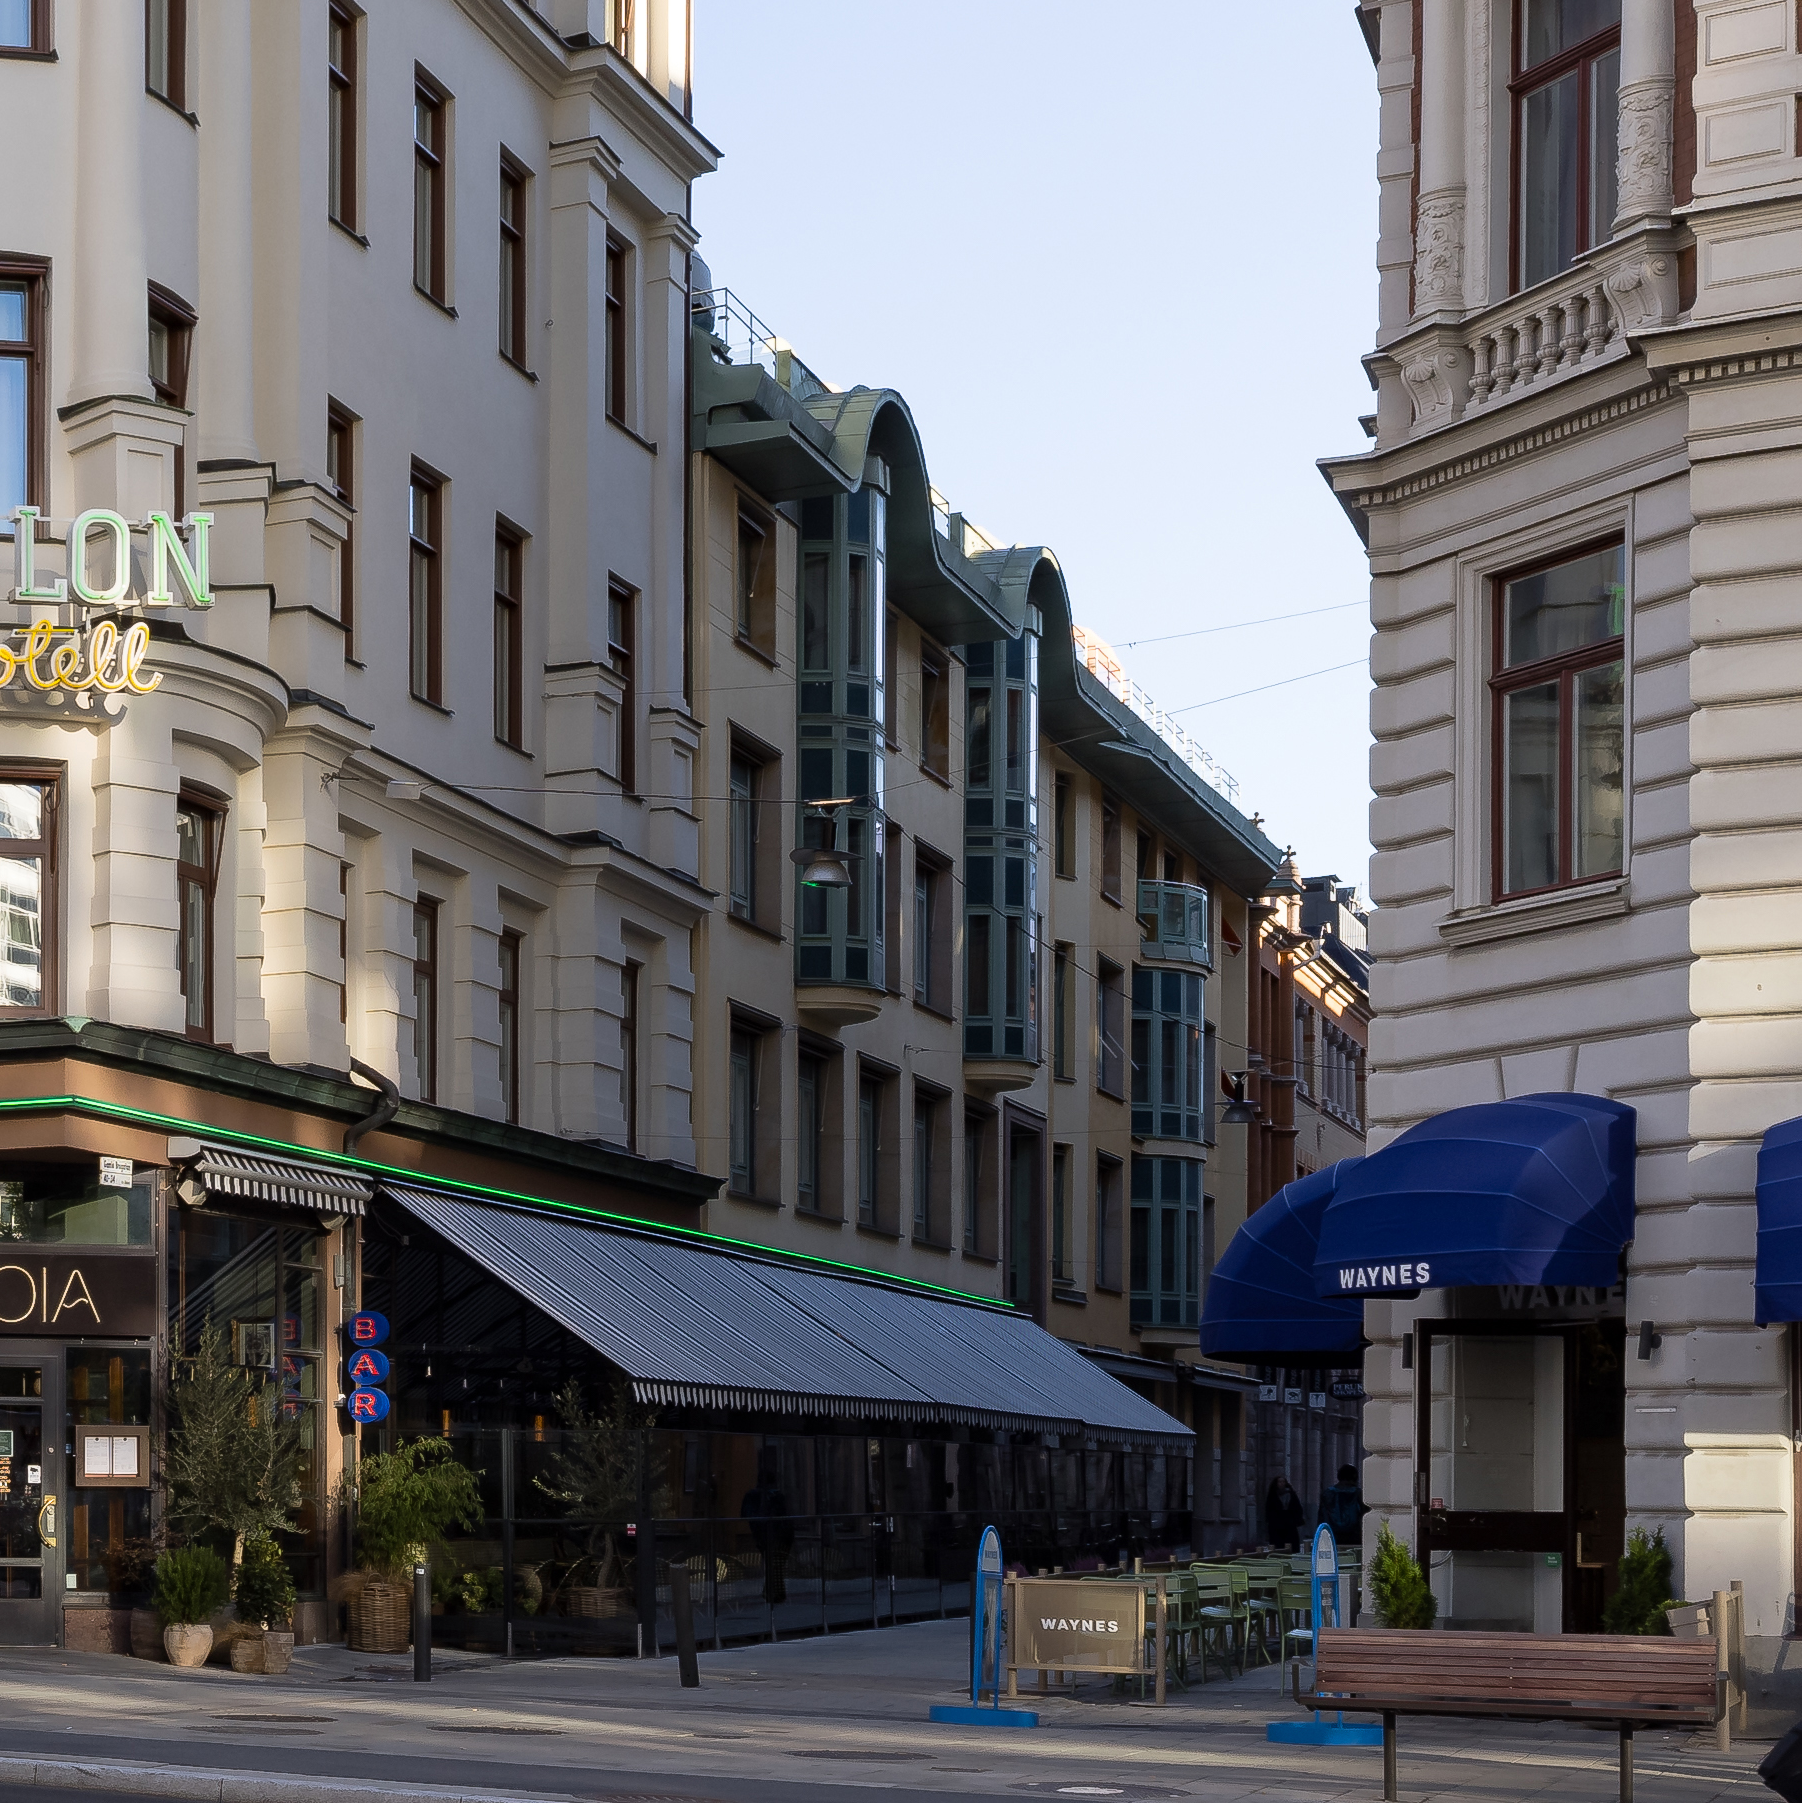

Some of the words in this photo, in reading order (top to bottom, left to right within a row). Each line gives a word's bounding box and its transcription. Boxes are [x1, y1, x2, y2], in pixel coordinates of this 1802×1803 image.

[1339, 1262, 1430, 1289] WAYNES
[351, 1317, 381, 1418] BAR
[1040, 1617, 1119, 1633] WAYNES
